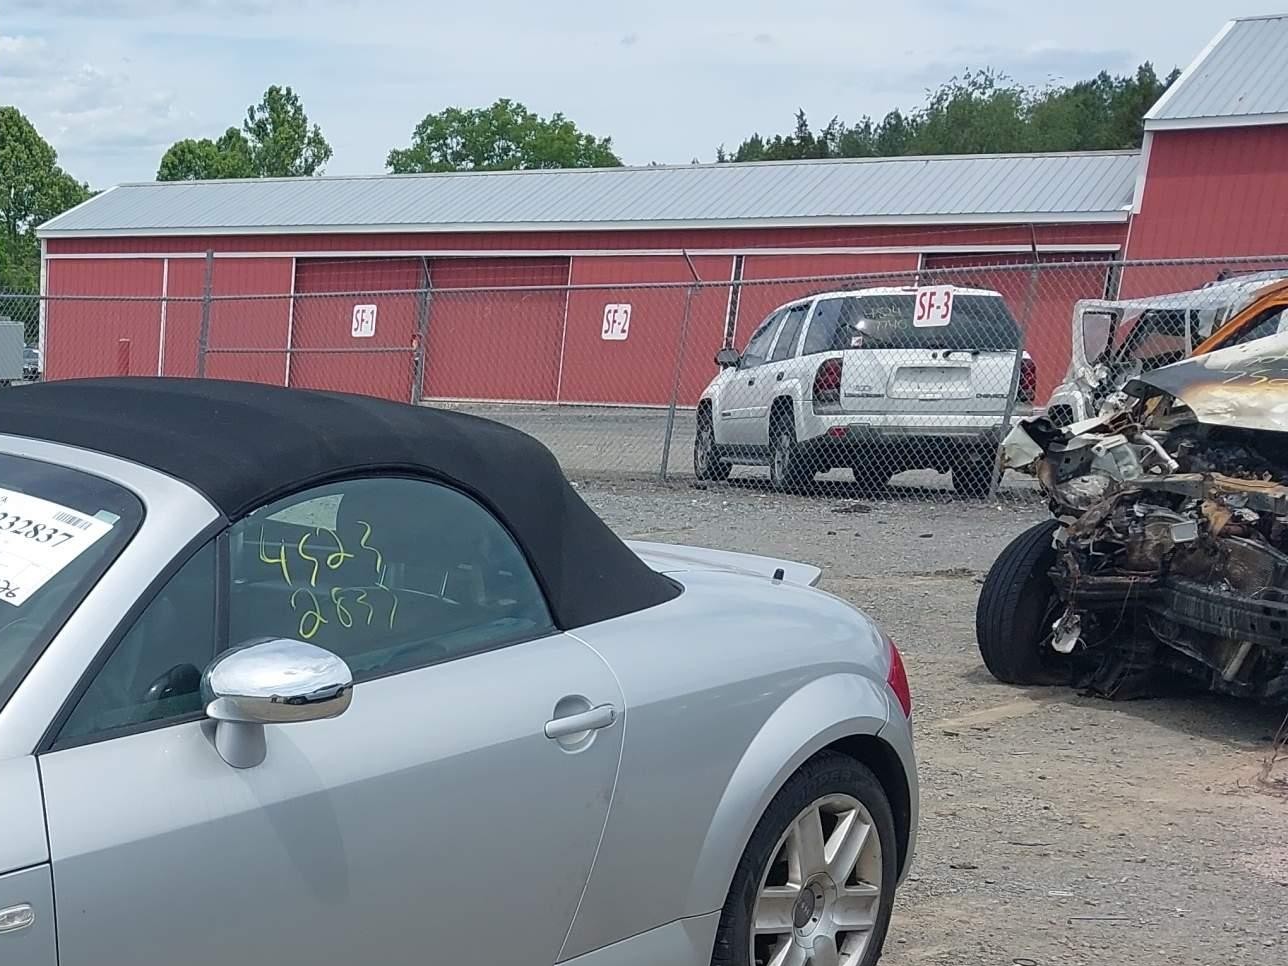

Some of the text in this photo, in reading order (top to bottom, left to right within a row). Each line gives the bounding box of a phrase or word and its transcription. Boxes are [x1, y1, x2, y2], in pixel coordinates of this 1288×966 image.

[917, 291, 951, 320] SF-3
[353, 309, 374, 332] SF-1
[604, 309, 628, 334] SF-2
[260, 521, 382, 587] 4523
